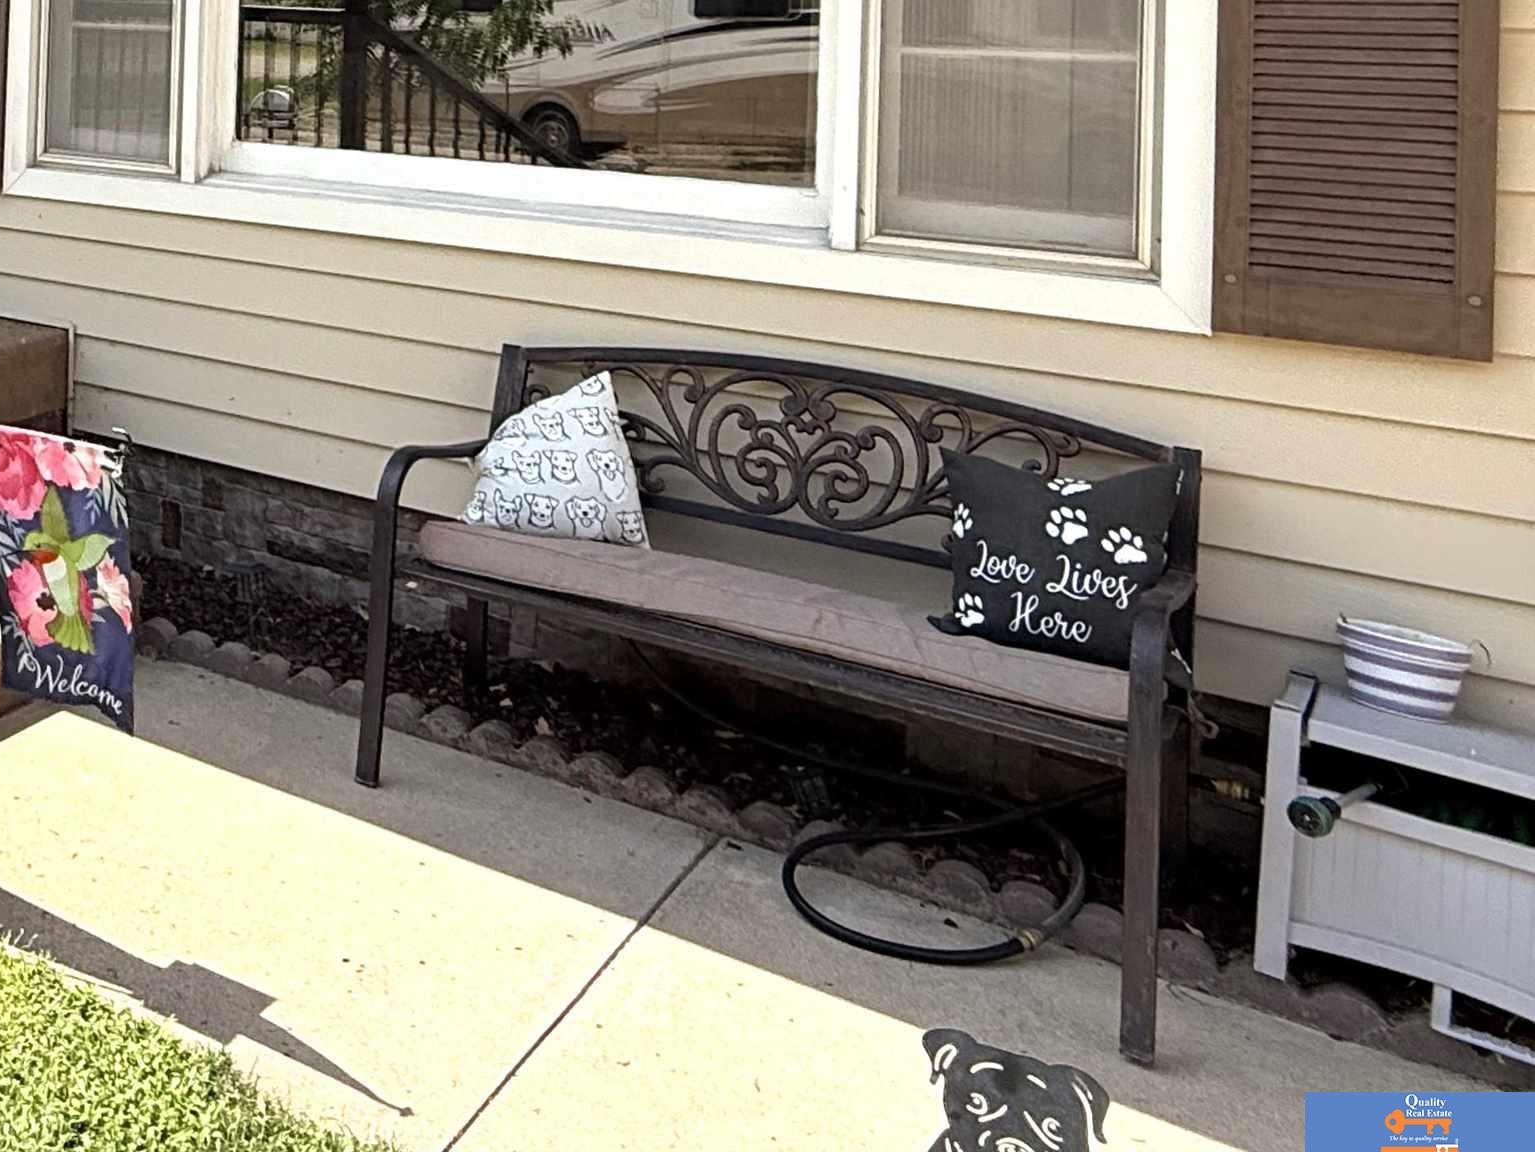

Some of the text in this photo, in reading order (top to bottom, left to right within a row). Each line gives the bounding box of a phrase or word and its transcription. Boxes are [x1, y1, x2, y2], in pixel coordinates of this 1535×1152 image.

[970, 539, 1138, 610] Love Lives
[1008, 591, 1093, 642] Here
[17, 652, 124, 715] Welcome
